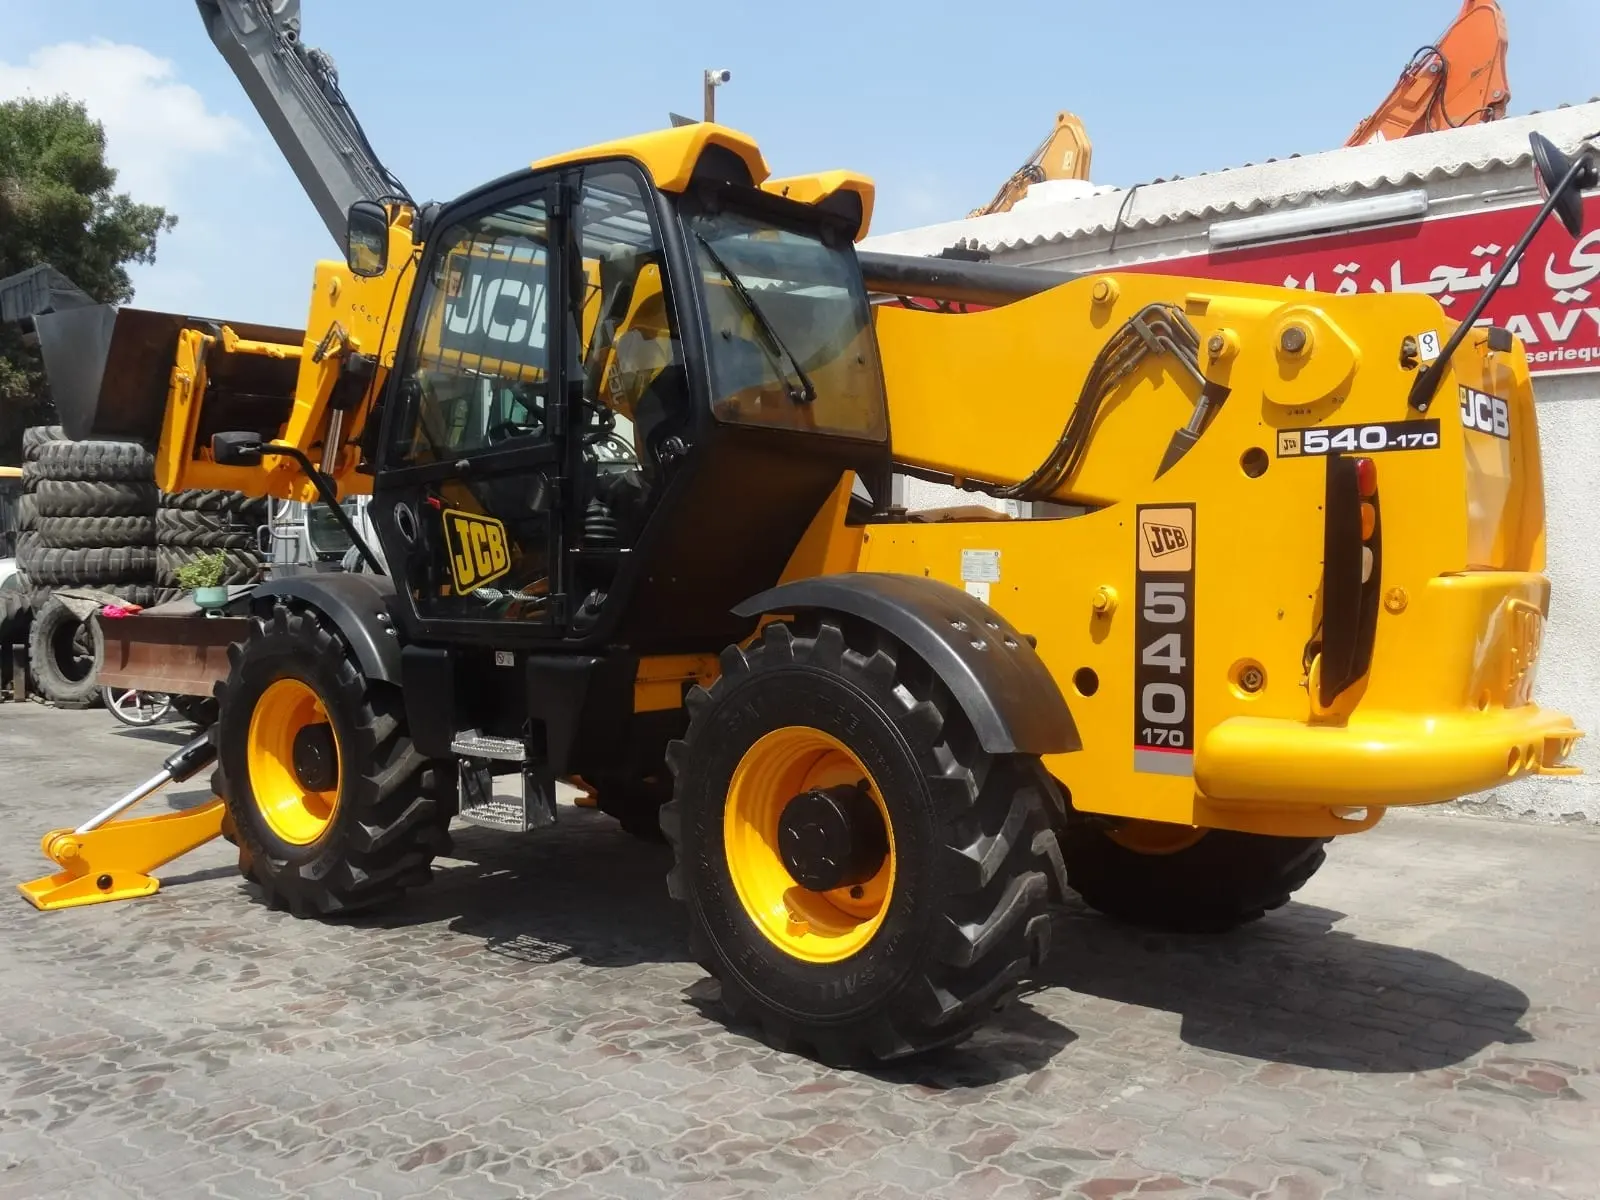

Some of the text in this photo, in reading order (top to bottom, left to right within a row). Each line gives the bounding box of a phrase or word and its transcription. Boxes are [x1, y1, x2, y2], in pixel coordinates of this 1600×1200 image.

[1474, 307, 1600, 343] AV
[1461, 389, 1509, 437] JCB
[1304, 425, 1438, 453] 540-170
[454, 518, 506, 585] JCB
[1151, 526, 1186, 553] JCB
[1142, 582, 1187, 724] 540
[1142, 727, 1184, 746] 170
